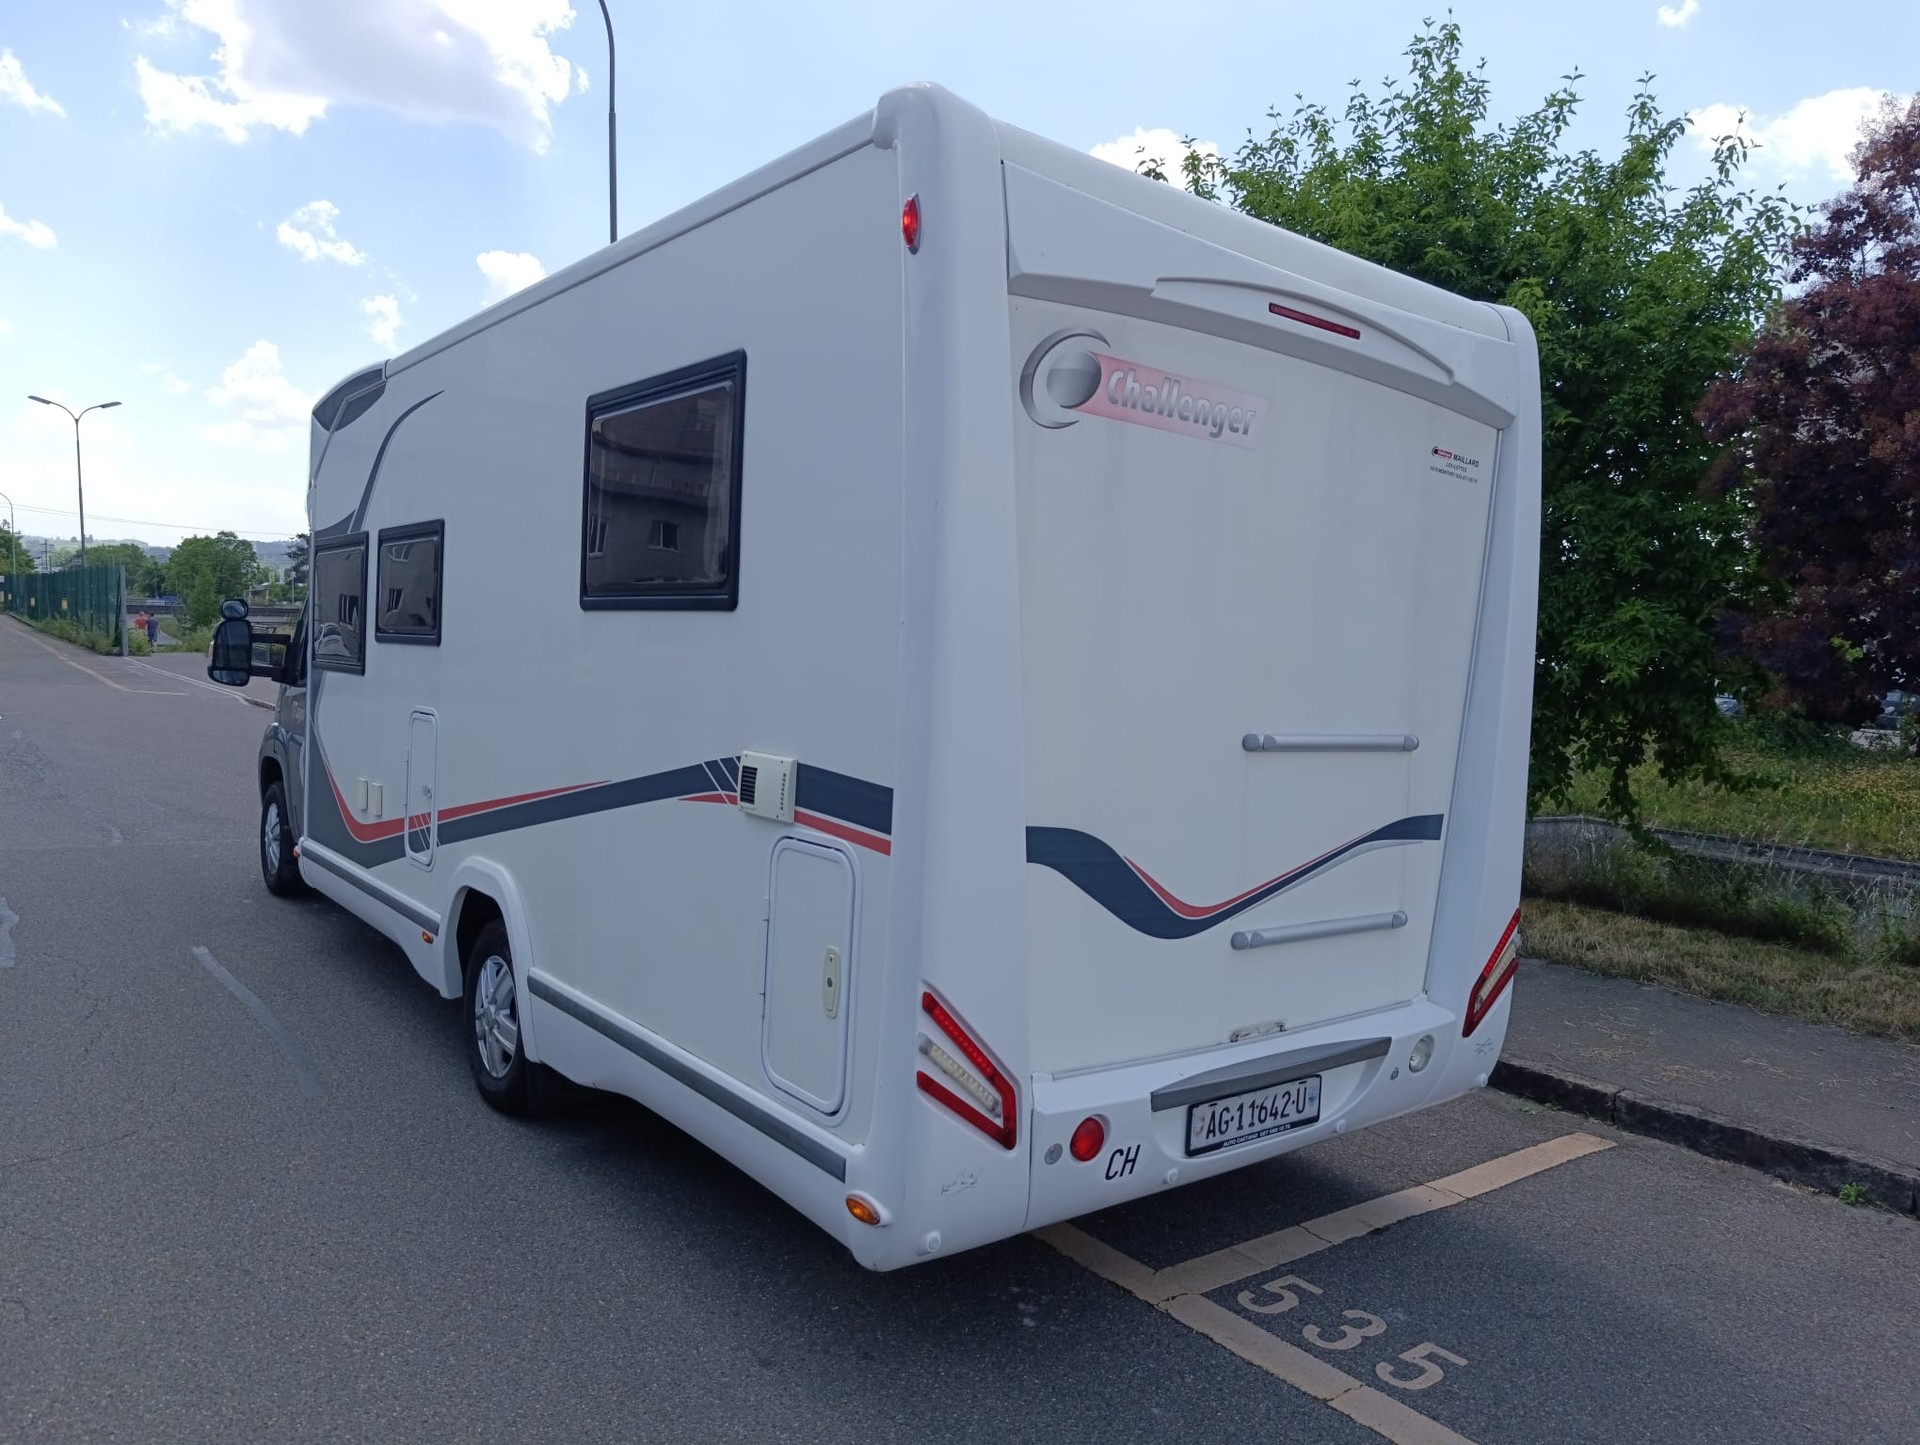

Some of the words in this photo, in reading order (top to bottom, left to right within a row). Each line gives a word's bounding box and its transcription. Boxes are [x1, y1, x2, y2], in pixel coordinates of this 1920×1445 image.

[1106, 368, 1257, 440] Challenger
[1453, 453, 1480, 468] MAILLARD
[1105, 1144, 1141, 1180] CH
[1237, 1274, 1469, 1389] 535
